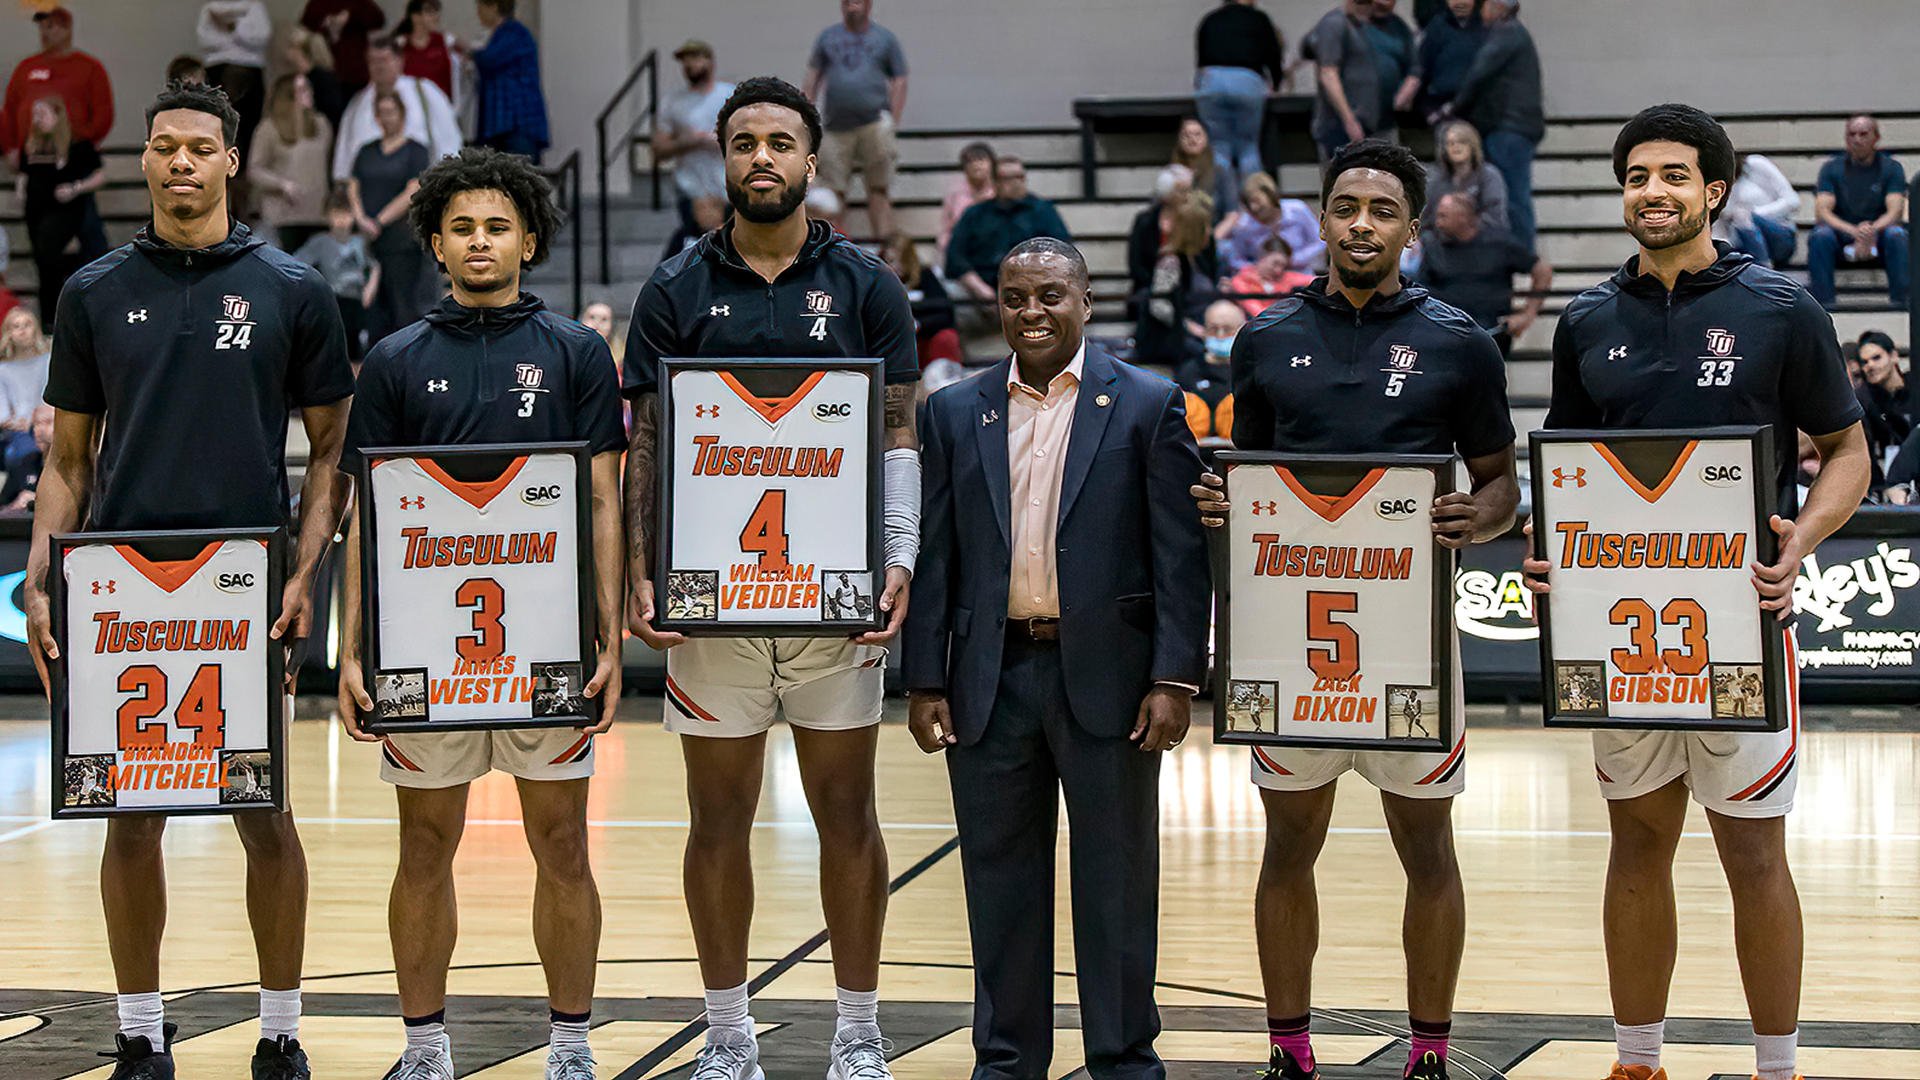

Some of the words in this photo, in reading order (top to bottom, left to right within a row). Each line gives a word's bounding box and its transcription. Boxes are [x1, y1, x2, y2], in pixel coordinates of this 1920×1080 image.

[222, 294, 251, 322] TU
[806, 290, 833, 313] TU
[215, 324, 252, 350] 24
[809, 317, 827, 341] 4
[1706, 328, 1736, 357] TU
[1390, 344, 1418, 370] TU
[516, 363, 543, 388] TU
[1384, 373, 1407, 397] 5
[1697, 360, 1735, 387] 33
[517, 392, 536, 417] 3
[816, 402, 851, 418] SAC
[692, 435, 844, 478] TUSCULUM
[1704, 465, 1742, 481] SAC
[525, 485, 561, 501] SAC
[1380, 499, 1417, 515] SAC
[739, 489, 789, 573] 4
[401, 527, 558, 569] TUSCULUM
[1252, 533, 1413, 580] TUSCULUM
[1556, 521, 1747, 569] TUSCULUM
[219, 573, 255, 588] SAC
[721, 583, 820, 609] VEDDER
[1454, 569, 1533, 620] SA
[93, 611, 250, 654] TUSCULUM
[456, 577, 506, 661] 3
[1306, 590, 1360, 680] 5
[1609, 598, 1709, 675] 33
[452, 655, 516, 676] JAMES
[430, 677, 508, 704] WEST
[509, 676, 539, 703] IV
[1312, 674, 1363, 693] ZACK
[1609, 676, 1709, 704] GIBSON
[116, 663, 225, 750] 24
[1293, 695, 1377, 723] DIXON
[122, 742, 214, 761] BRANDON
[106, 762, 231, 790] MITCHELL
